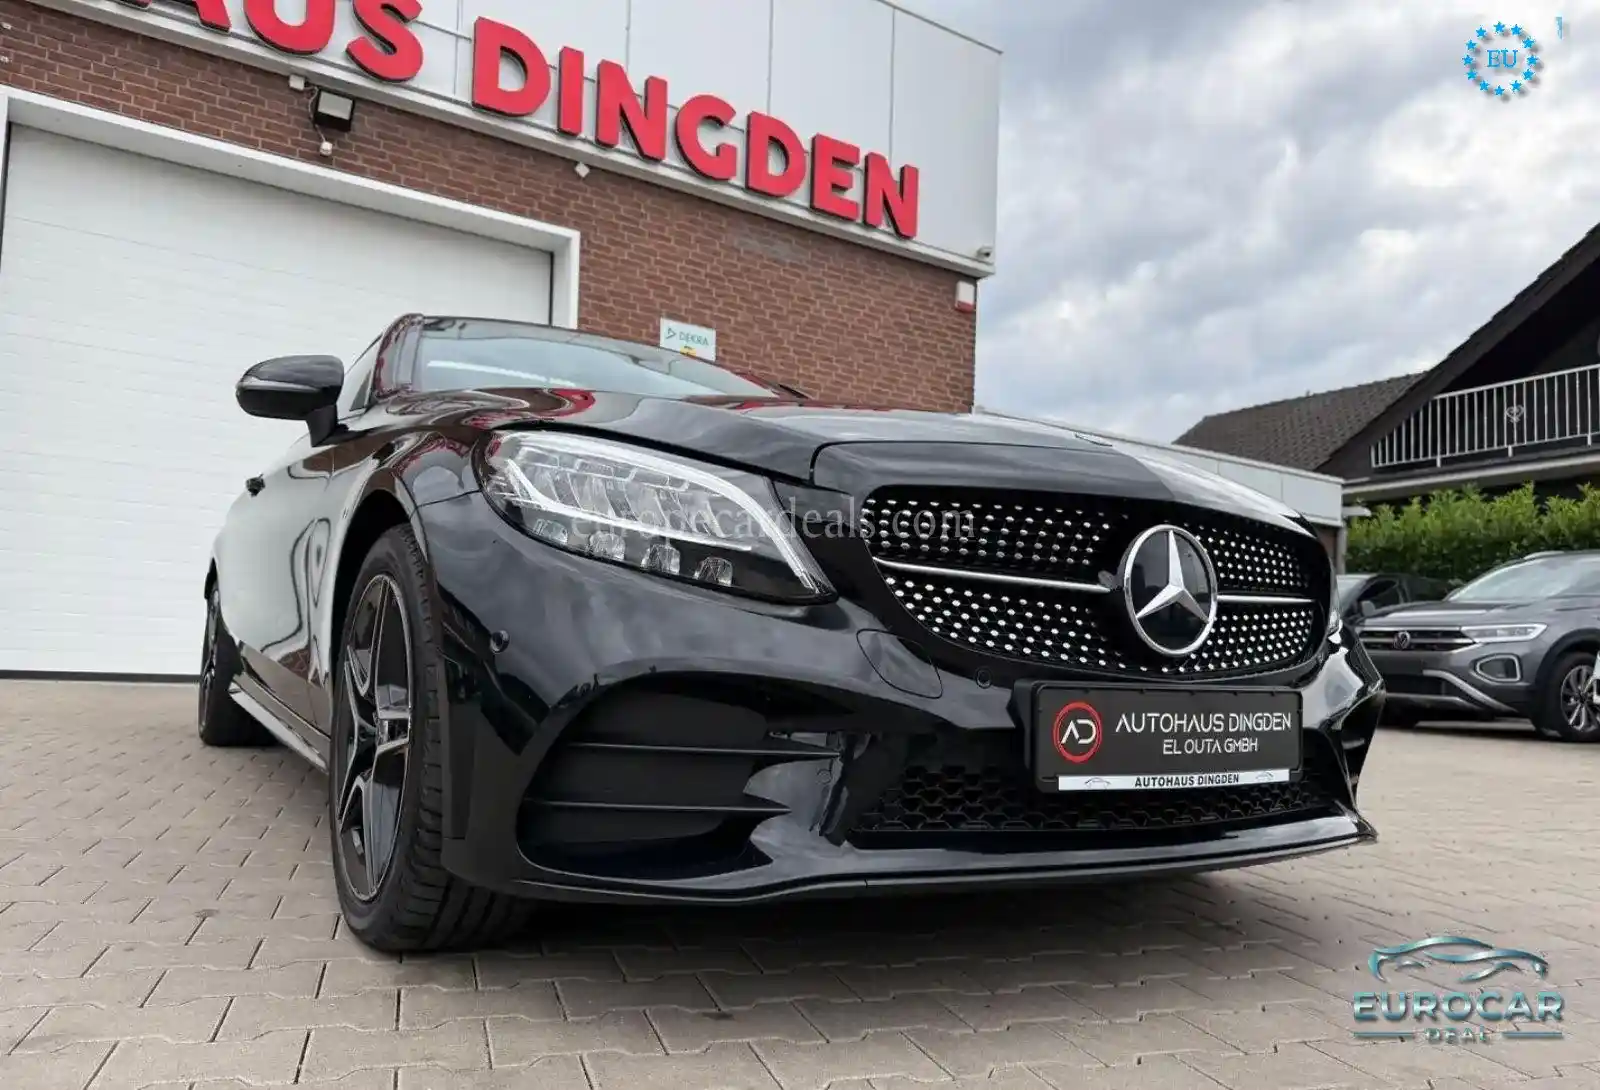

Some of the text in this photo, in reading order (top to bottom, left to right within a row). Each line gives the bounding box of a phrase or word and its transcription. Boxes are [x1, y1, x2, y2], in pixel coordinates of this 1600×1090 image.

[106, 0, 919, 238] US DINGDEN
[1115, 712, 1292, 733] AUTOHAUS DINGDEN
[1162, 739, 1182, 755] EL
[1184, 738, 1222, 754] OUTA
[1134, 773, 1240, 788] AUTOHAUS DINGDEN
